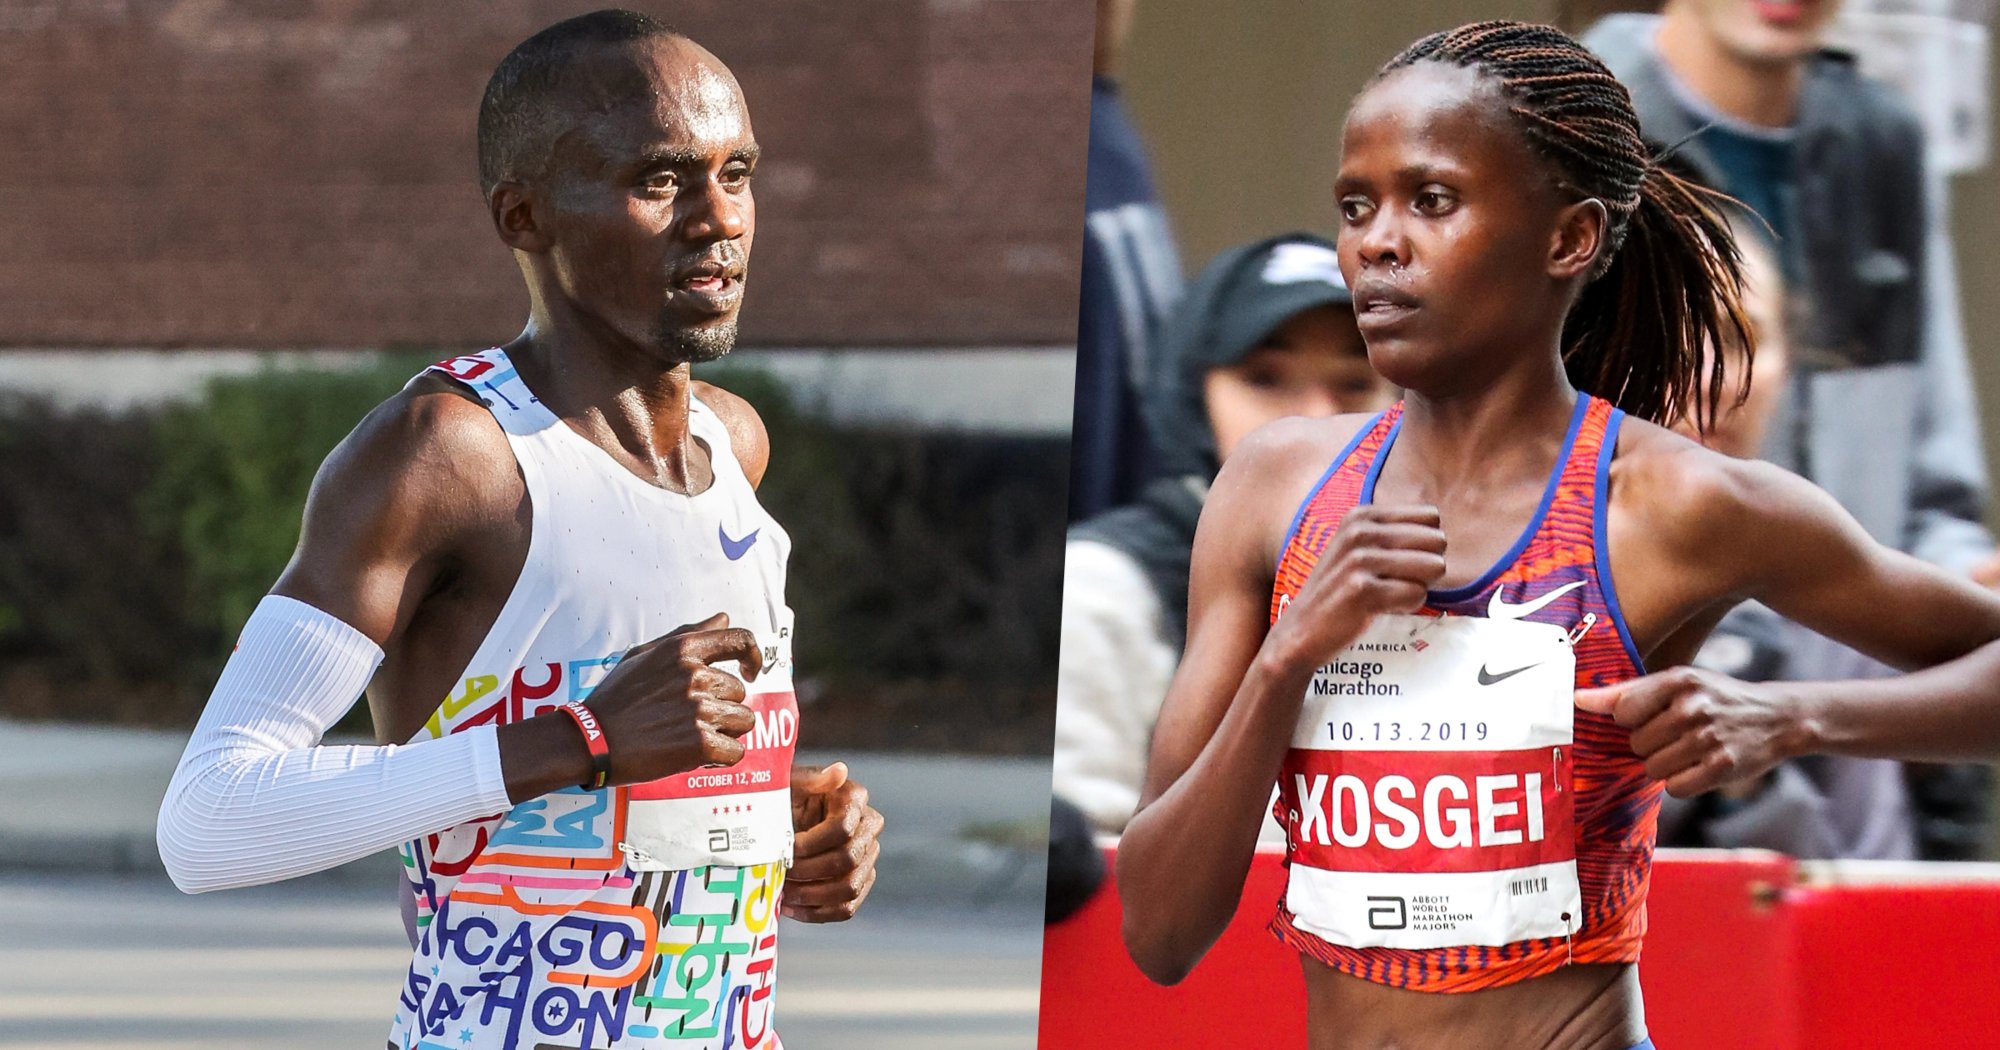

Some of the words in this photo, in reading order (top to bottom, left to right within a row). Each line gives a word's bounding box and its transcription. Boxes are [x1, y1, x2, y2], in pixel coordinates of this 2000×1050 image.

[1358, 643, 1407, 652] AMERICA
[1314, 679, 1400, 696] Marathon
[743, 709, 796, 750] IMO
[1327, 722, 1488, 741] 10.13.2019
[687, 774, 733, 789] OCTOBER
[735, 772, 749, 785] 12,
[751, 770, 771, 783] 2025
[1295, 772, 1545, 849] KOSGEI
[1412, 896, 1450, 904] ABBOTT
[1412, 905, 1448, 913] WORLD
[1413, 914, 1473, 922] MARATHON
[1413, 922, 1456, 931] MAJORS
